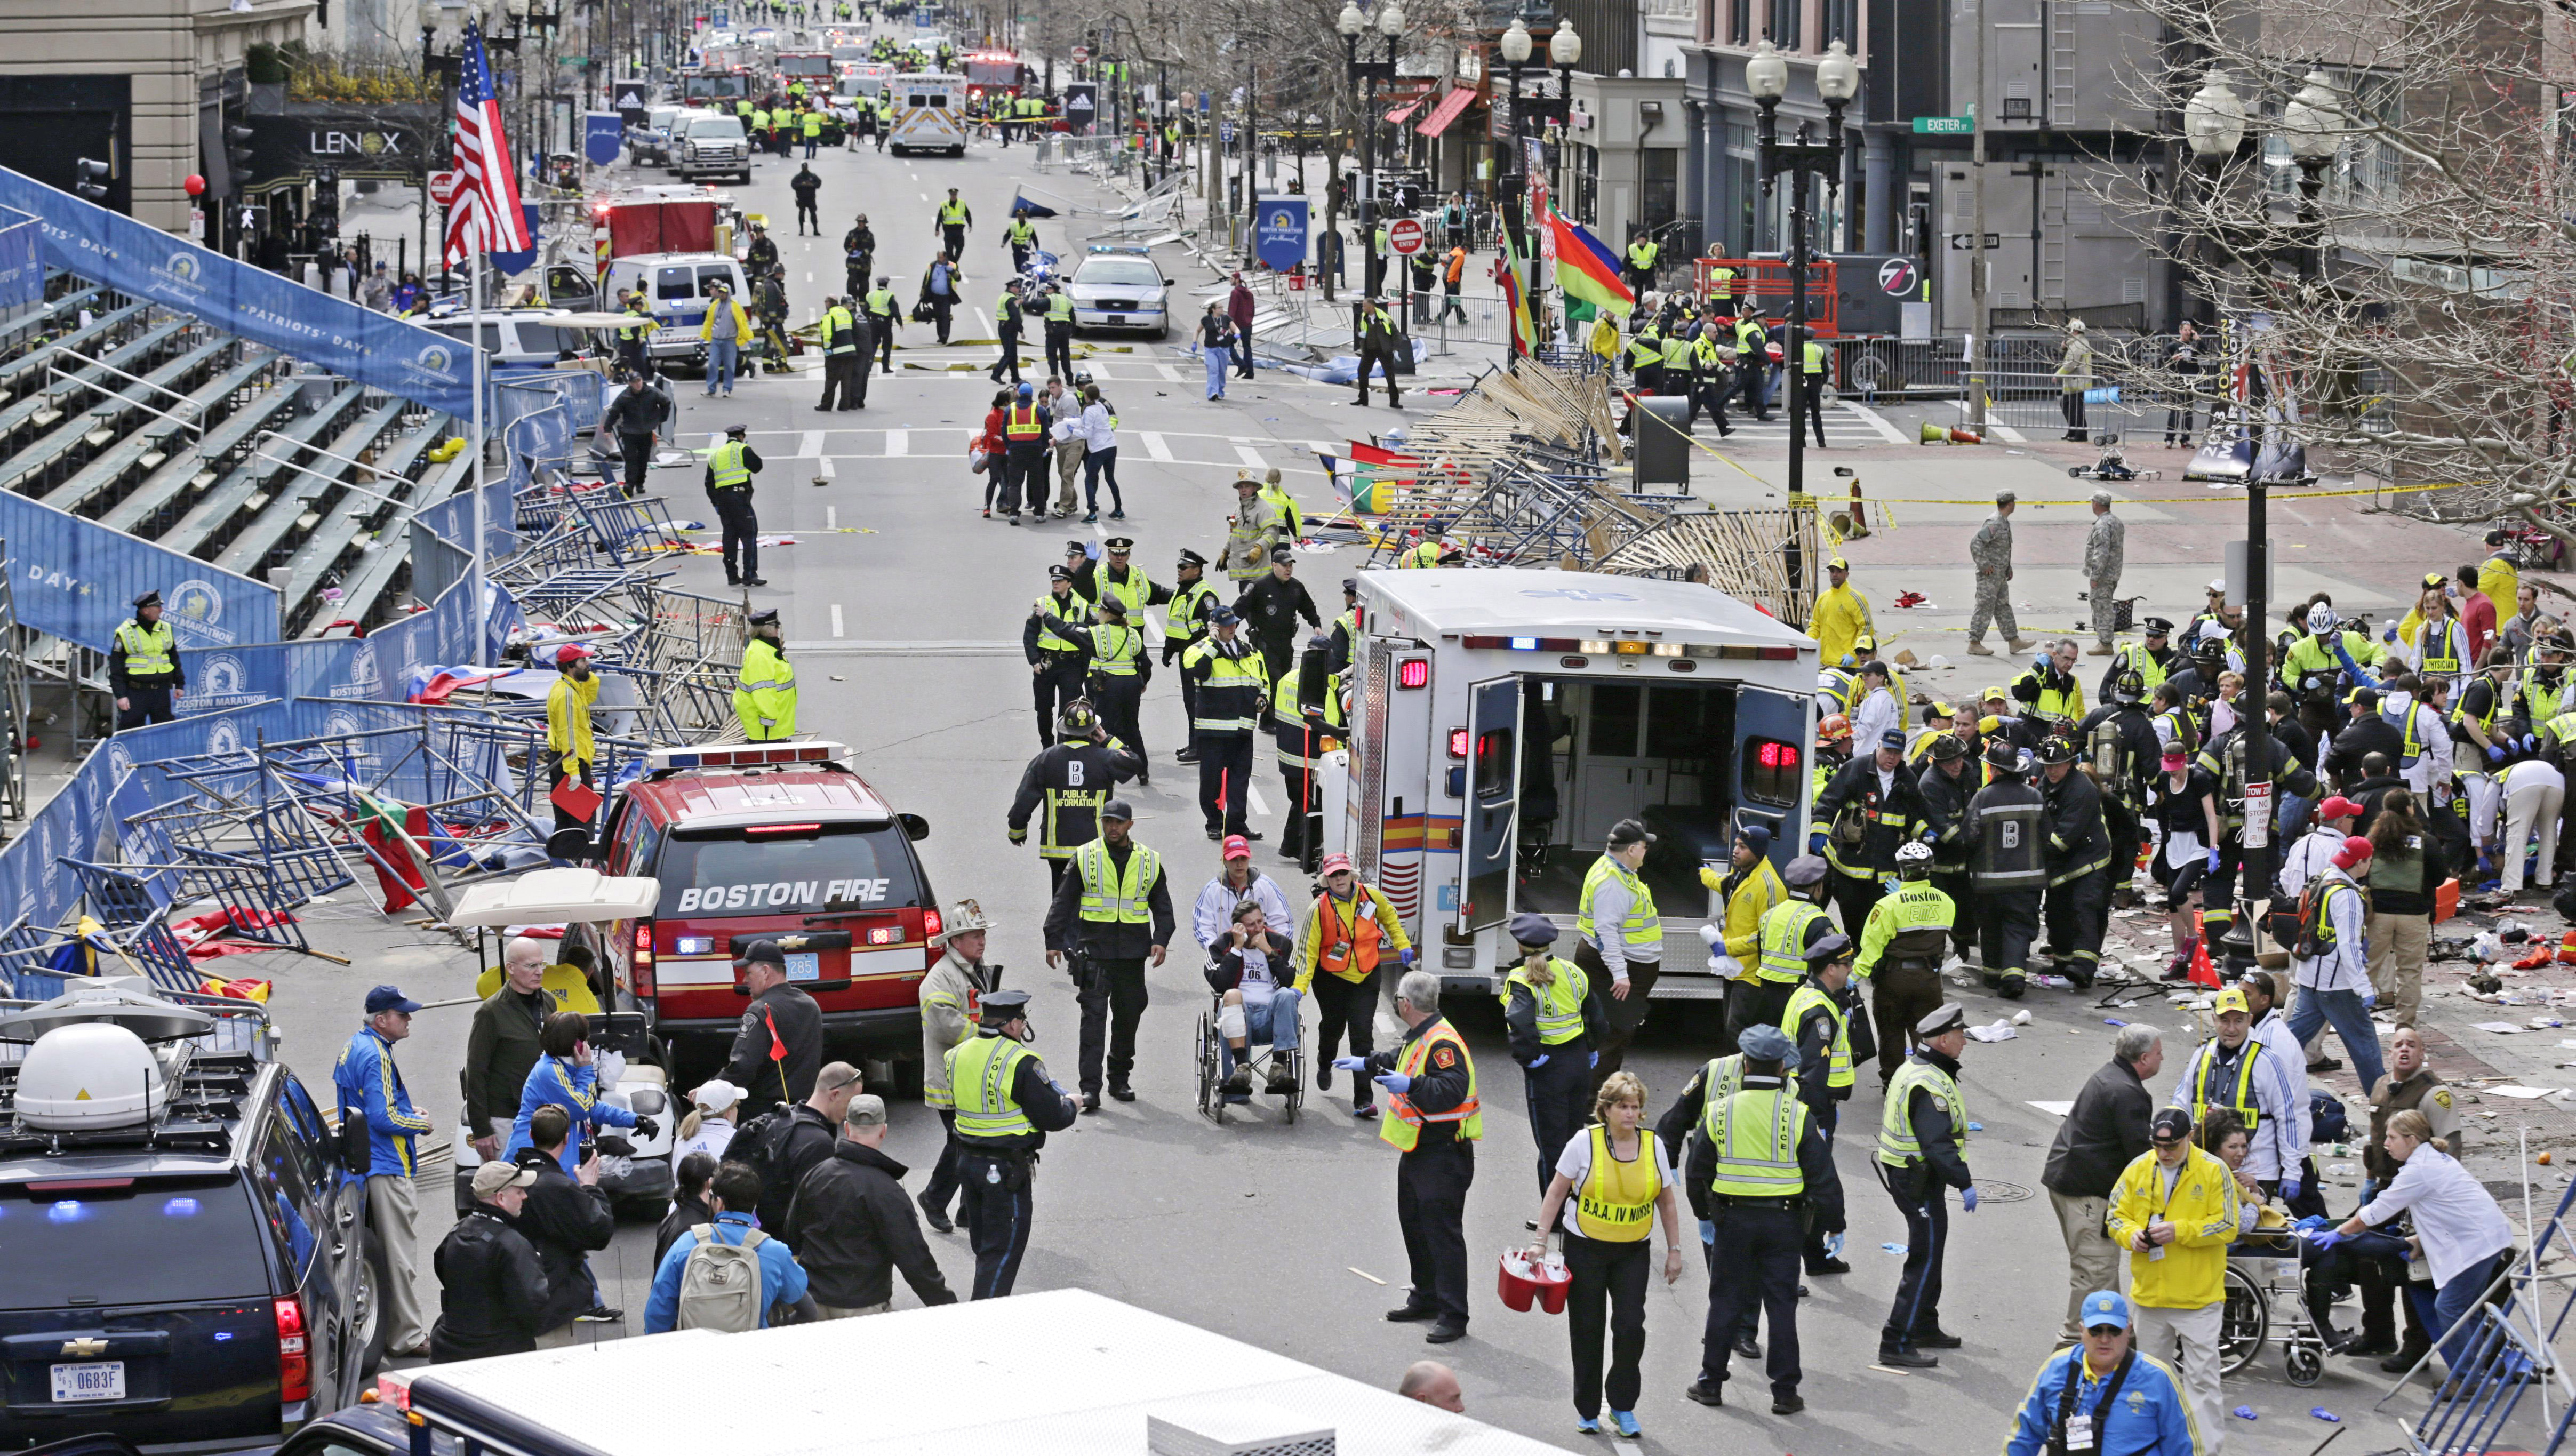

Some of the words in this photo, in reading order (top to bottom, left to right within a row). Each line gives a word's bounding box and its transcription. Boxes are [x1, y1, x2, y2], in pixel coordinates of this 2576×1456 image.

[1927, 119, 1960, 131] EXETER
[79, 238, 111, 257] DAY
[1398, 240, 1416, 248] ENTER
[247, 306, 326, 338] PATRIOTS'
[332, 335, 364, 353] DAY
[2217, 318, 2229, 400] BOSTON
[28, 564, 78, 591] DAY
[1136, 573, 1144, 601] POICE
[159, 613, 177, 625] TON
[179, 618, 234, 644] MARATHON
[1101, 630, 1109, 660] BOSTON
[2428, 660, 2454, 670] PHYSICIAN
[176, 697, 213, 709] BOSTON
[215, 694, 266, 707] MARATHON
[330, 686, 365, 697] BOSTON
[2047, 747, 2055, 757] 7
[1063, 789, 1089, 798] PUBLIC
[2246, 787, 2261, 797] TOW
[2258, 800, 2268, 809] NO
[1089, 849, 1098, 888] BOSTON
[1141, 851, 1150, 892] POLICE
[678, 881, 817, 913] BOSTON
[824, 878, 890, 903] FIRE
[1900, 890, 1942, 903] Boston
[1909, 905, 1940, 922] EMS
[1786, 909, 1806, 949] POLICE
[790, 960, 813, 974] 285
[1248, 970, 1261, 980] 06
[1544, 996, 1552, 1017] TON
[987, 1056, 1002, 1105] POLICE
[1718, 1075, 1729, 1099] BOS
[1717, 1103, 1726, 1146] OSTON
[1780, 1100, 1790, 1151] POLICE
[1583, 1198, 1611, 1221] B.A.A.
[1615, 1207, 1627, 1222] IV
[1629, 1202, 1651, 1222] NURSE
[78, 1371, 116, 1390] 0683F
